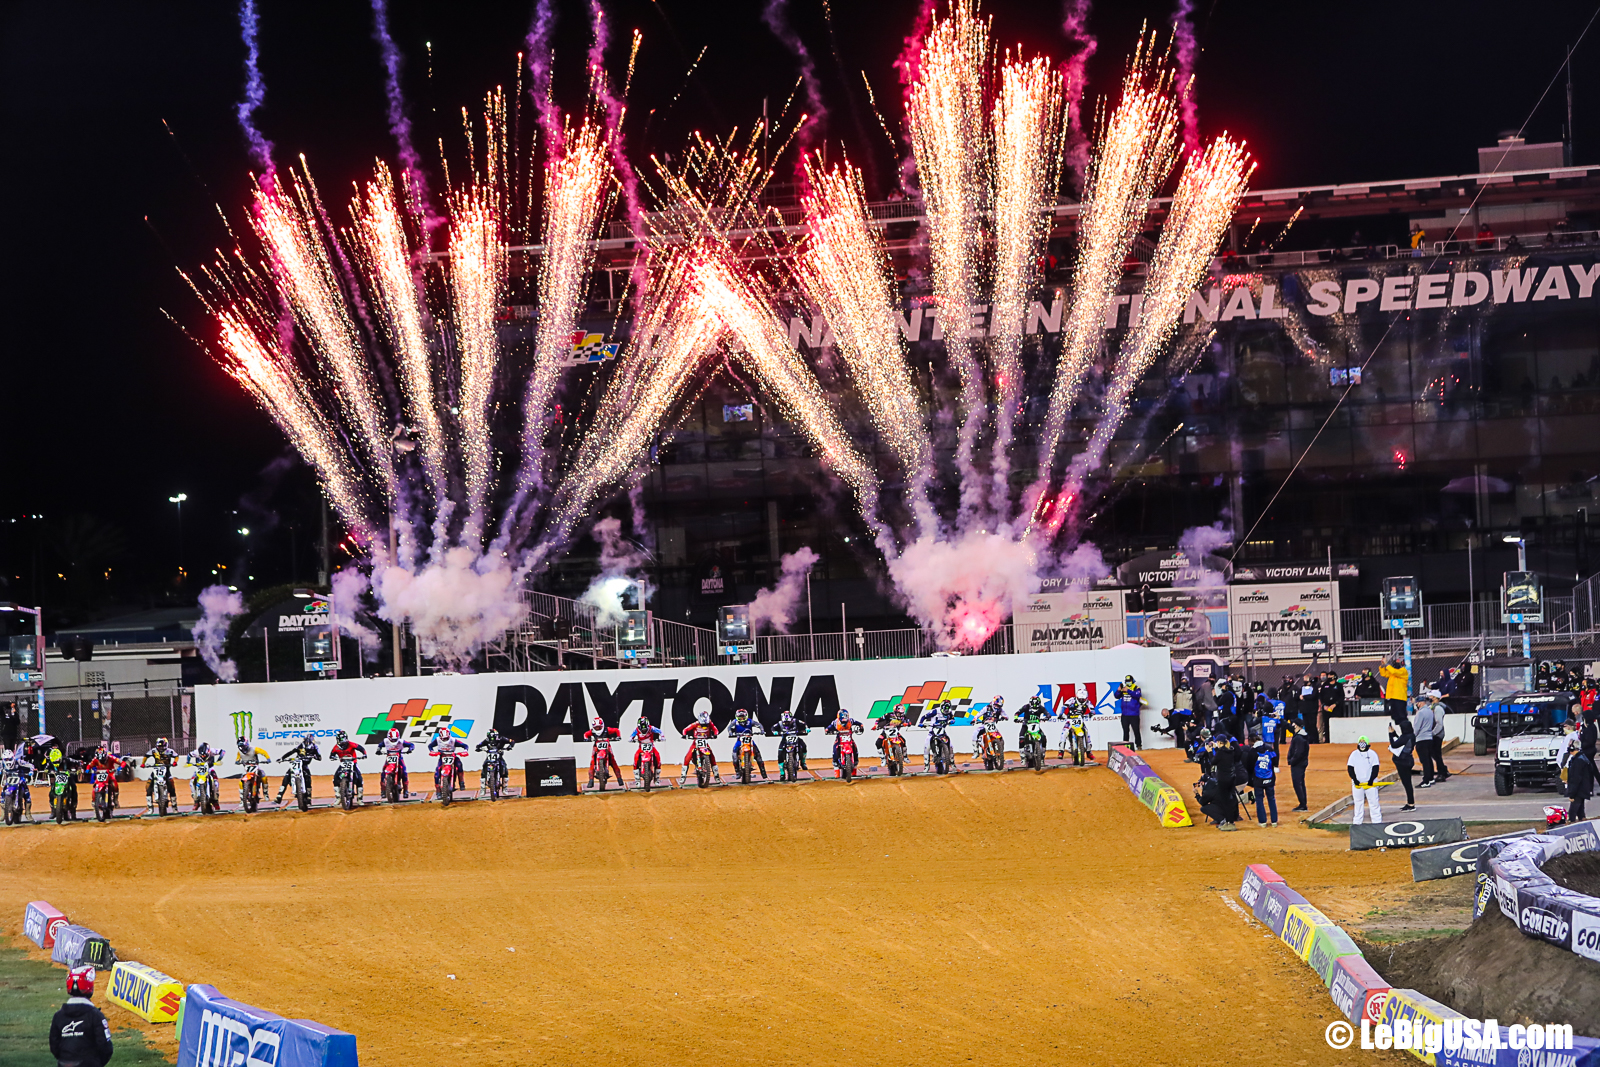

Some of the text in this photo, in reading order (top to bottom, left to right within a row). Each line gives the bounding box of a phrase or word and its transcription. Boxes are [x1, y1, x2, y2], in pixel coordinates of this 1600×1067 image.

[1307, 263, 1600, 316] SPEEDWAY
[1139, 569, 1182, 582] VICTORY
[1265, 566, 1332, 577] VICTORY LANE
[1064, 576, 1090, 586] LANE
[1083, 601, 1113, 609] DAYTONA
[1250, 619, 1321, 632] DAYTONA
[1031, 627, 1104, 641] DAYTONA
[492, 674, 840, 743] DAYTONA
[275, 713, 321, 723] MONSTER
[257, 728, 341, 740] SUPERCROSS
[888, 728, 897, 736] 2
[642, 743, 652, 751] 23
[697, 739, 707, 747] 51
[1375, 834, 1436, 847] OAKLEY
[1564, 832, 1597, 854] OMETIC
[1442, 861, 1477, 876] OAK
[1521, 907, 1570, 941] COMETIC
[112, 968, 152, 1013] SUZUKI
